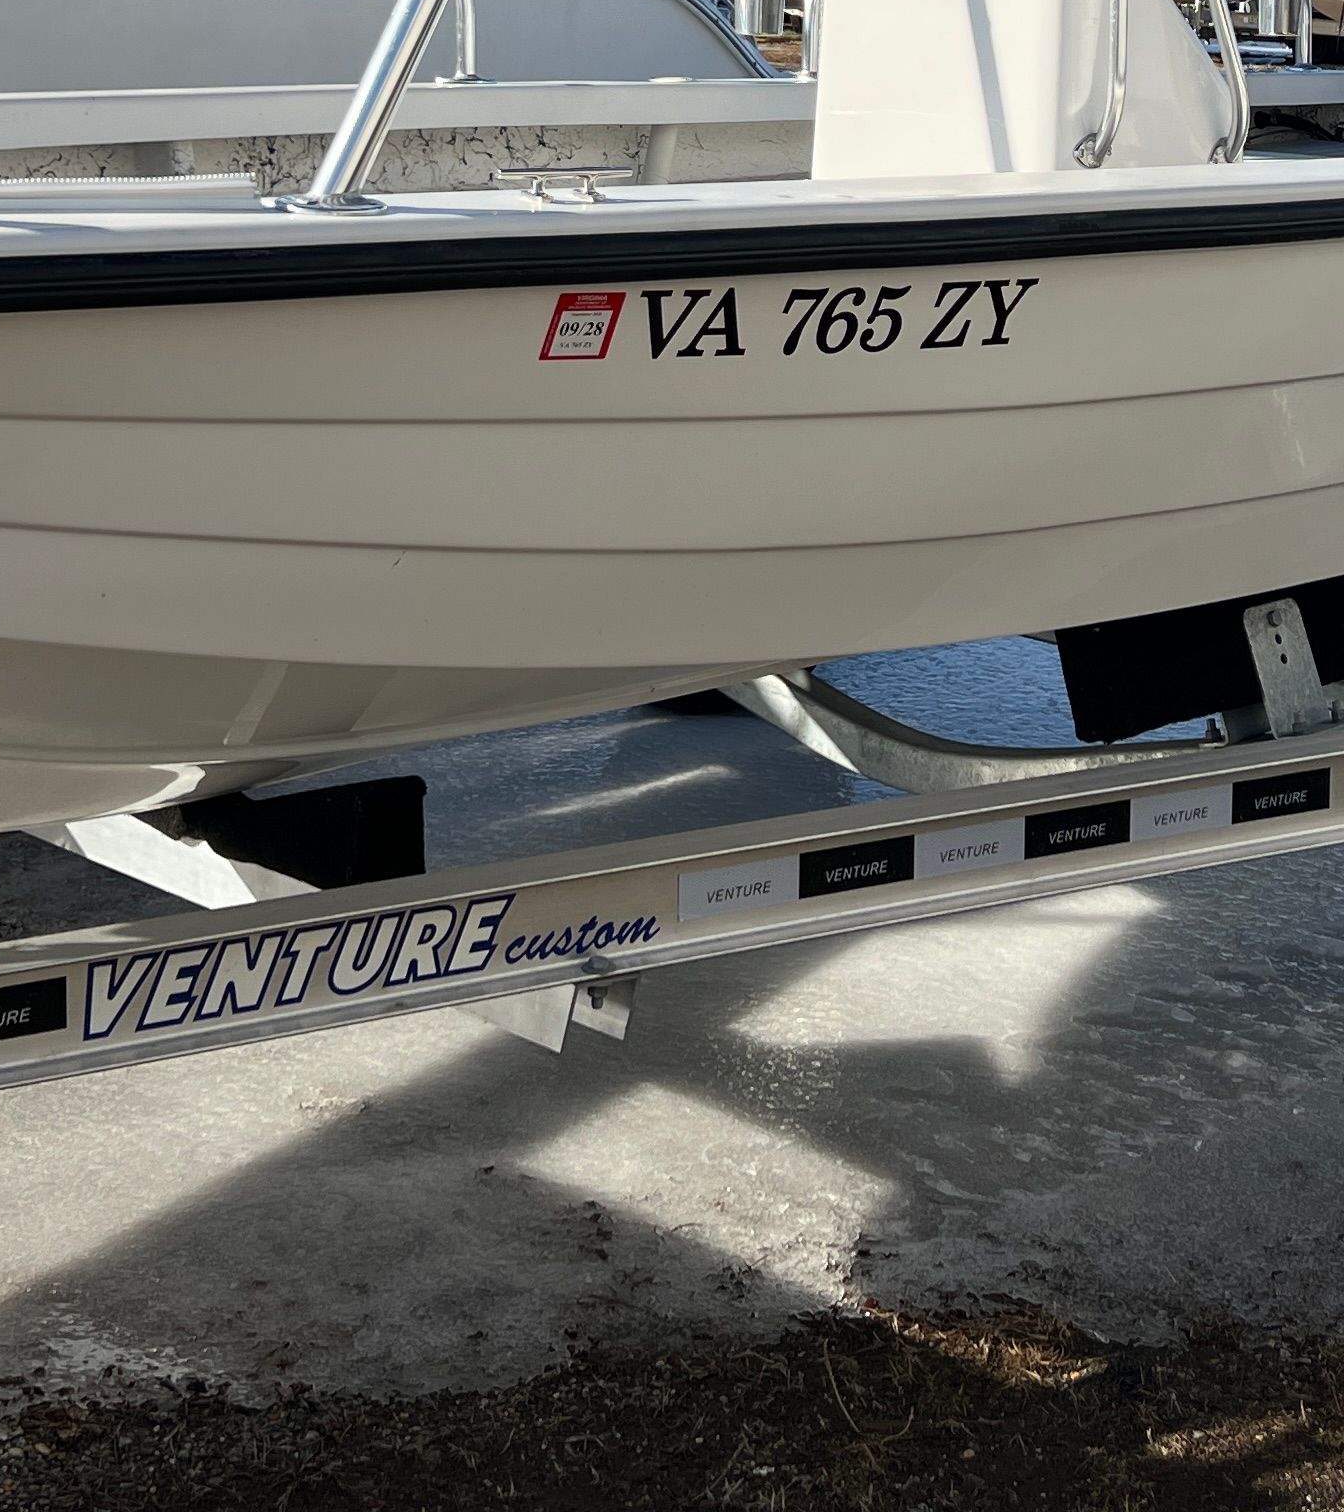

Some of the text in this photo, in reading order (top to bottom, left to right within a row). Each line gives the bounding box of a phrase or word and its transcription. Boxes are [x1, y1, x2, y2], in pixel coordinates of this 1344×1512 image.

[559, 321, 605, 337] 09/28
[640, 288, 747, 360] VA
[781, 285, 913, 356] 765
[920, 278, 1040, 350] ZY
[1254, 790, 1308, 810] VENTURE
[1153, 807, 1209, 827] VENTURE
[1049, 823, 1106, 844] VENTURE
[940, 842, 999, 864] VENTURE
[825, 859, 888, 884] VENTURE
[706, 879, 772, 904] VENTURE
[83, 893, 660, 1041] VENTURE custom
